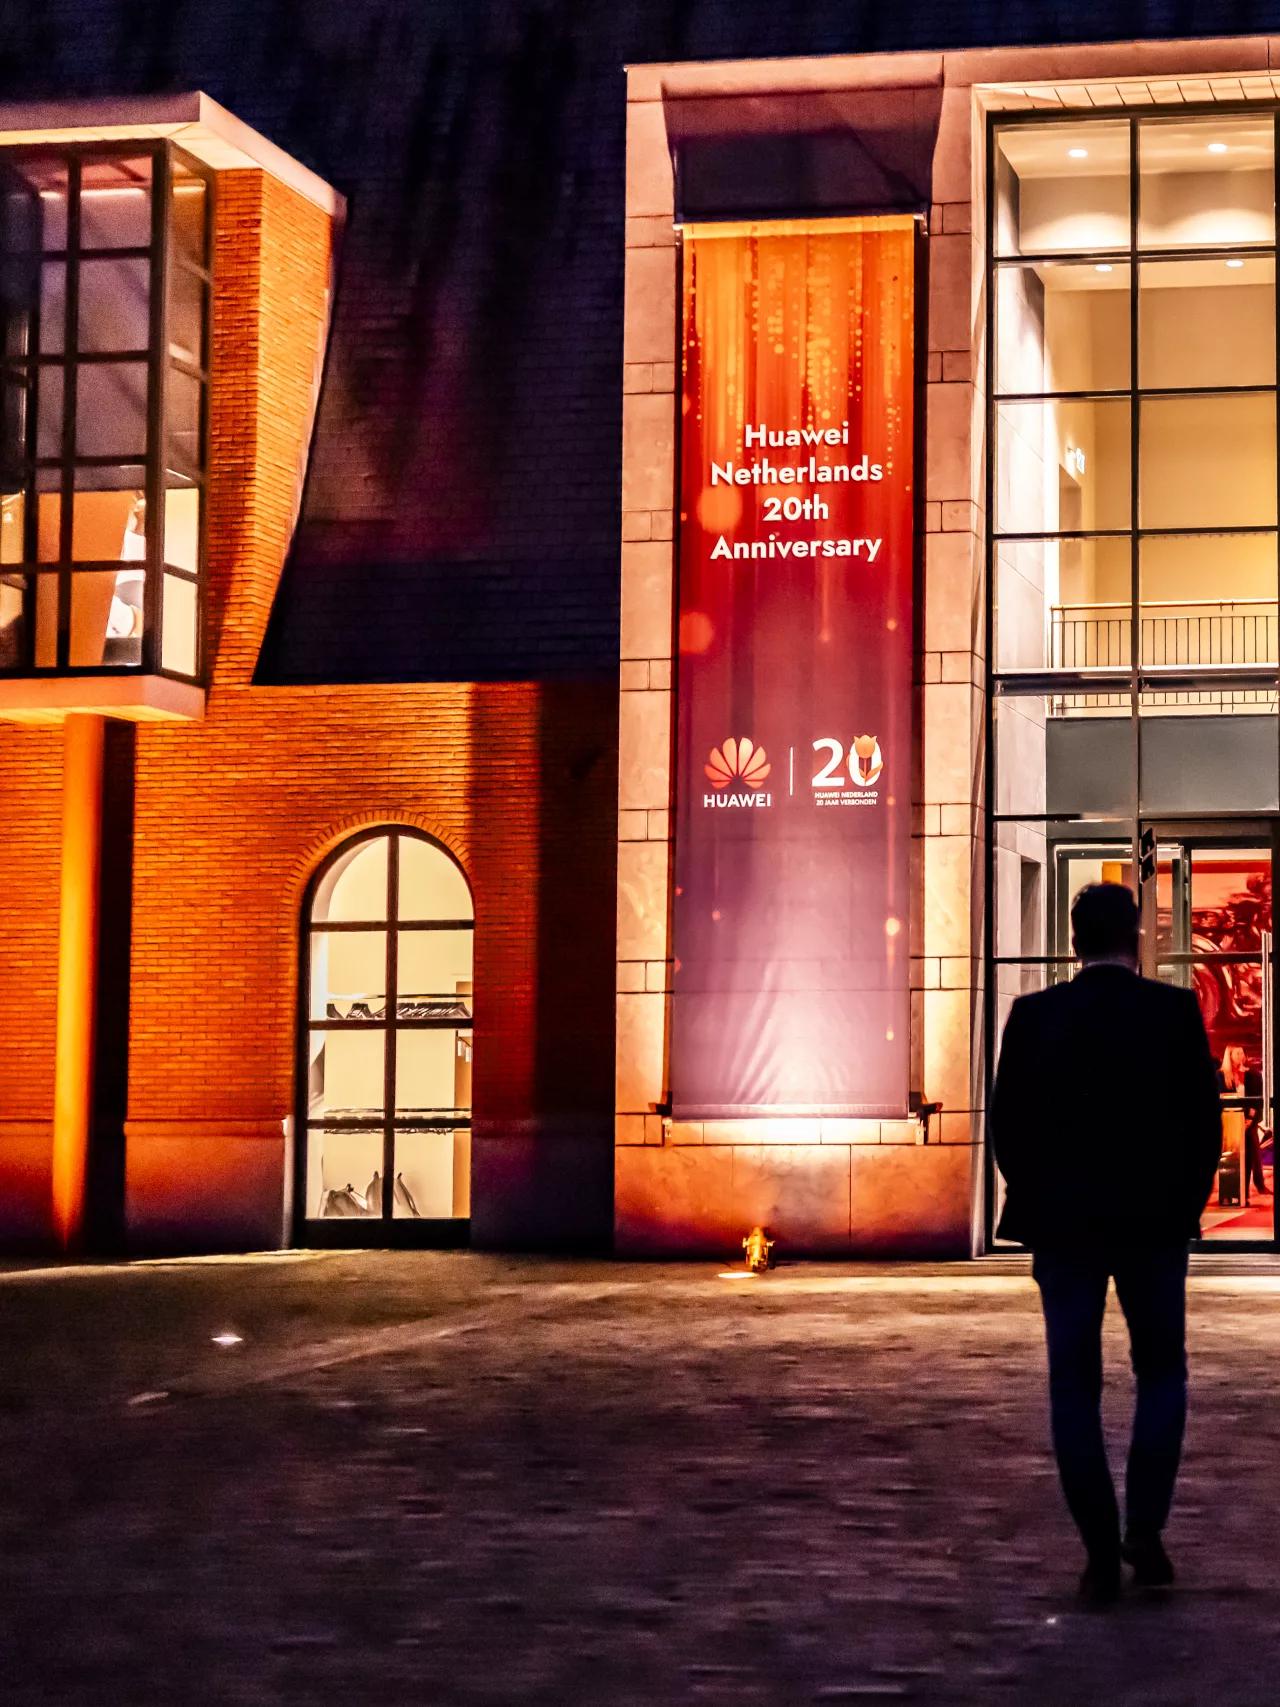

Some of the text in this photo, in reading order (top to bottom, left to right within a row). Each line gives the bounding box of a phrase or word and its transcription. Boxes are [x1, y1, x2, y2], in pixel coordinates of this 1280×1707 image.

[745, 420, 849, 447] Huawei
[711, 454, 883, 486] Netherlands
[762, 493, 829, 521] 20th
[710, 534, 882, 562] Anniversary
[811, 735, 883, 787] 20
[703, 793, 771, 808] HUAWEI
